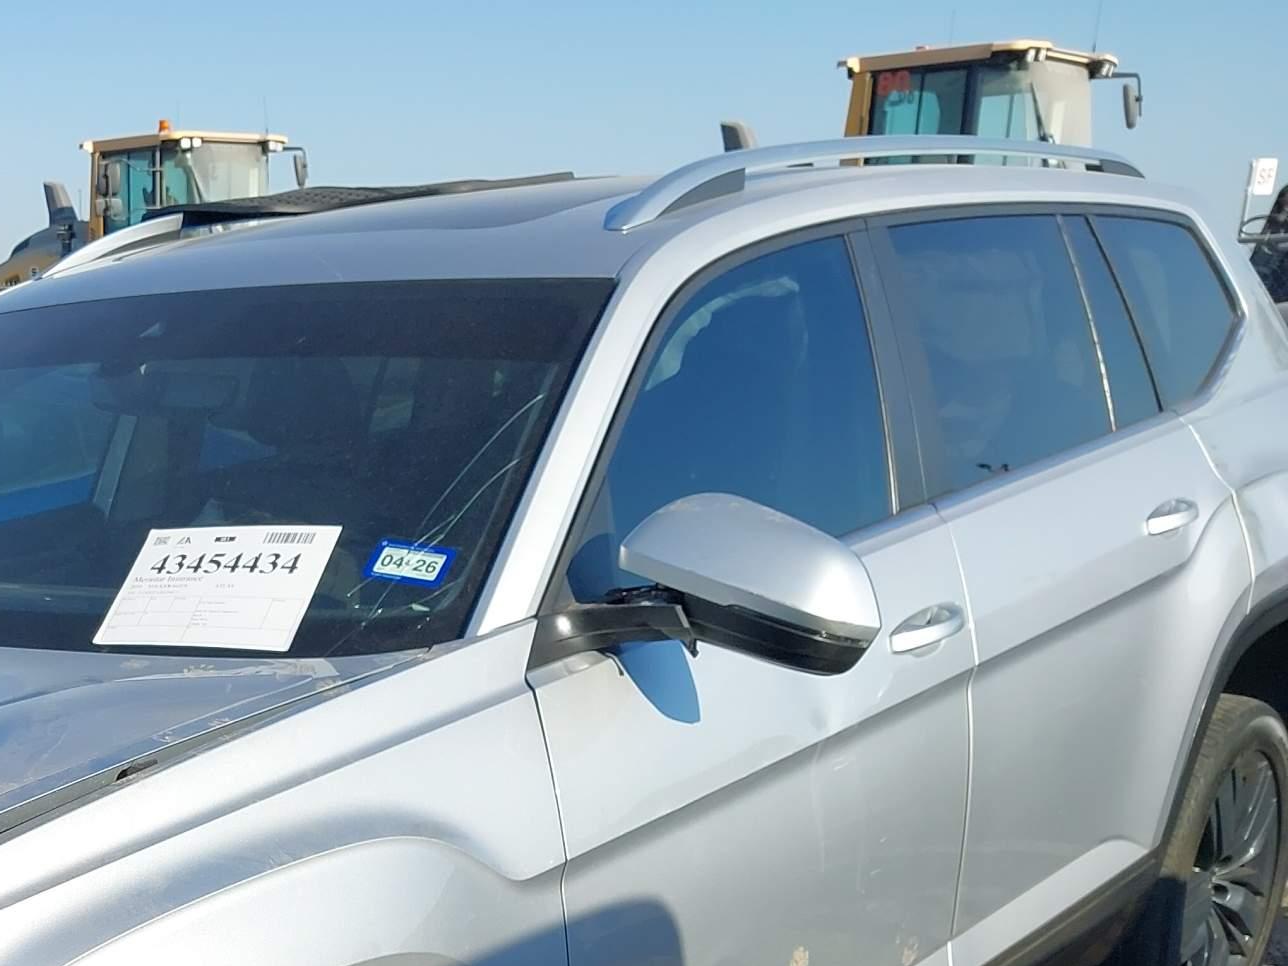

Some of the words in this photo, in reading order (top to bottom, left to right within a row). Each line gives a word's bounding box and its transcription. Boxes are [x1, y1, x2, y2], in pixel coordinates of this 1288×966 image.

[151, 552, 303, 575] 43454434
[380, 554, 404, 569] 04
[412, 559, 439, 574] 26
